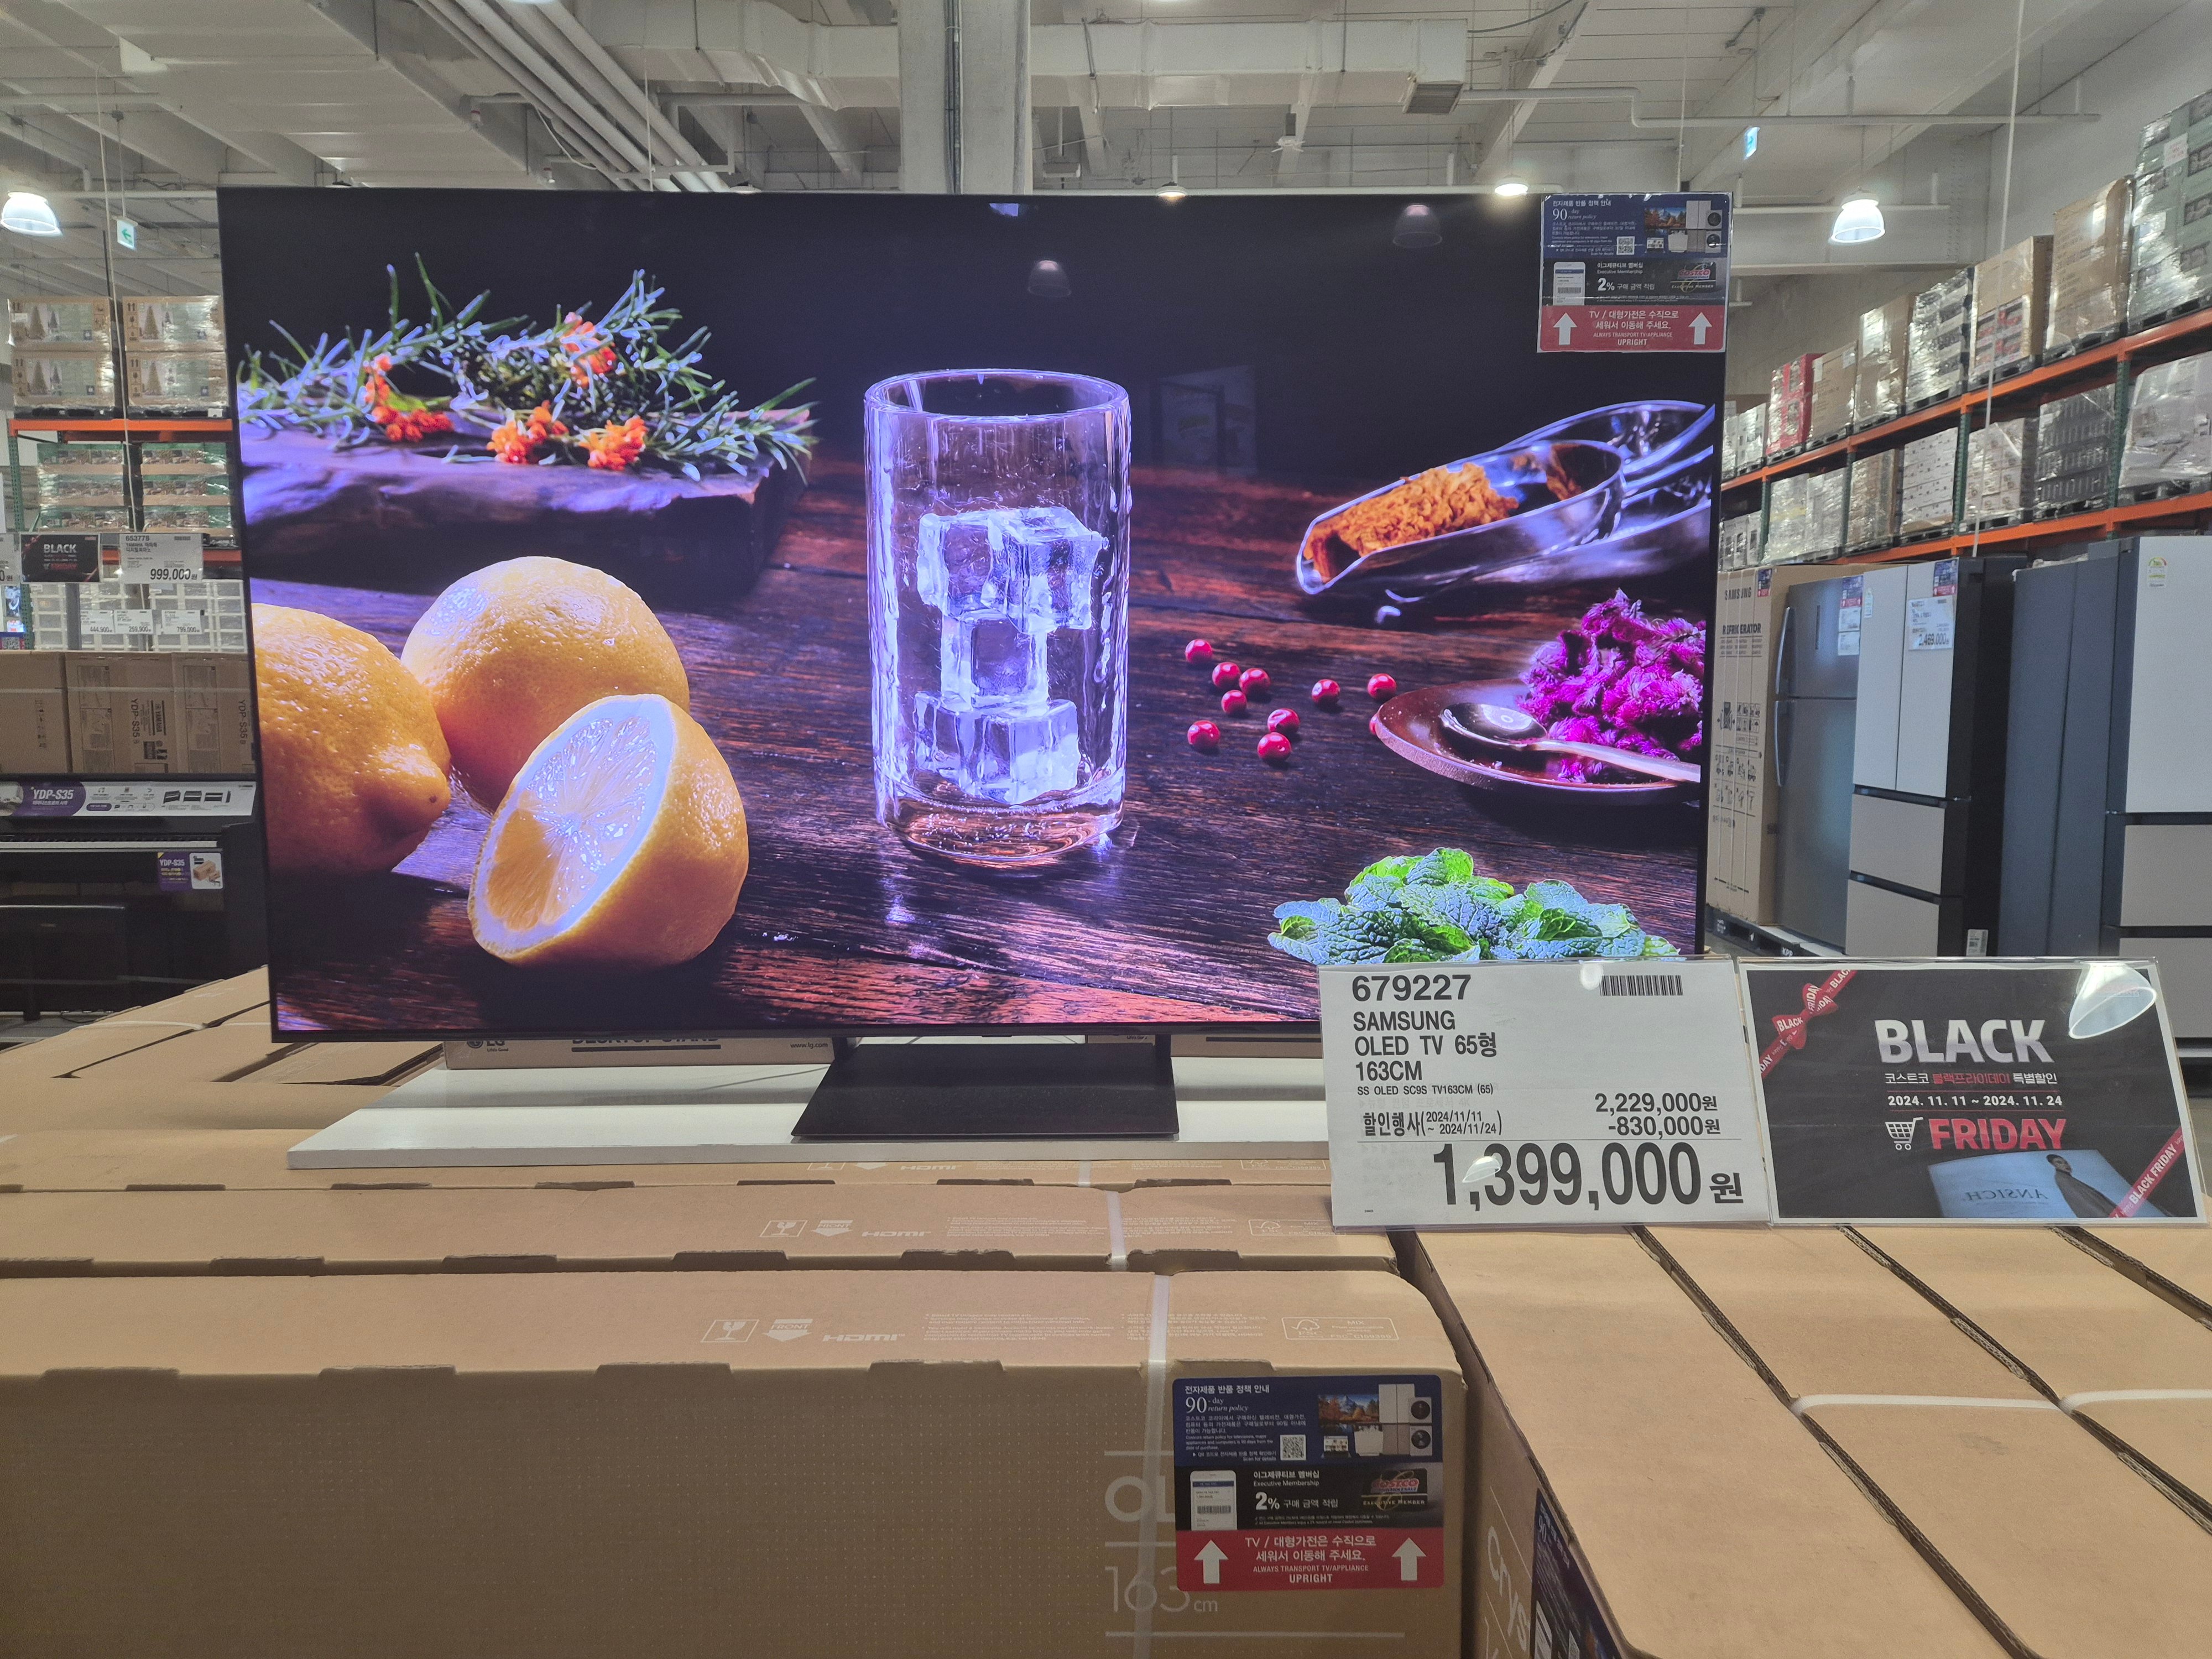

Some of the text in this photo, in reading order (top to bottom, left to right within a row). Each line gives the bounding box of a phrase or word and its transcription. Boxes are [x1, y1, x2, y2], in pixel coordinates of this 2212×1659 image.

[1552, 208, 1567, 220] 90
[1597, 278, 1615, 291] 2%
[1609, 310, 1646, 319] 대형가전은
[1648, 310, 1679, 319] 수직으로
[1596, 321, 1671, 330] 세워서 이동해 주세요.
[44, 544, 77, 553] BLACK
[150, 568, 191, 581] 999,000
[131, 698, 140, 738] YDP-S35
[33, 789, 74, 800] YDP-S35
[1352, 974, 1471, 1001] 679227
[1353, 1010, 1455, 1031] SAMSUNG
[1777, 1016, 1803, 1032] BLACK
[1354, 1032, 1497, 1057] OLED TV 65형
[1875, 1019, 2055, 1063] BLACK
[1355, 1061, 1422, 1081] 163CM
[1885, 1072, 2058, 1084] 코스트코 블랙프라이데이 특별할인
[1357, 1083, 1493, 1095] SS OLED SC9S TV163CM (65)
[1595, 1093, 1718, 1116] 2,229,000원
[1887, 1095, 1924, 1106] 2024.
[1928, 1095, 1948, 1106] 11.
[1952, 1095, 1966, 1106] 11
[1984, 1095, 2020, 1106] 2024.
[2023, 1095, 2043, 1106] 11.
[2047, 1095, 2063, 1106] 24
[1426, 1109, 1482, 1122] 2024/11/11
[1928, 1118, 2067, 1150] FRIDAY
[1433, 1142, 1744, 1211] 1,399,000 원
[2129, 1143, 2177, 1204] BLACK FRIDAY
[1185, 1384, 1270, 1394] 전자제품 반품 정책 안내
[1185, 1397, 1207, 1413] 90
[1229, 1405, 1249, 1413] policy
[1253, 1470, 1319, 1479] 이그제큐티브 멤버십
[1105, 1474, 1175, 1522] OL
[1255, 1491, 1338, 1510] 2% 구매 금액 적립
[1245, 1537, 1260, 1547] TV
[1274, 1536, 1328, 1548] 대형가전은
[1332, 1535, 1376, 1547] 수직으로
[1256, 1549, 1365, 1562] 세워서 이동해 주세요.
[1289, 1573, 1333, 1583] UPRIGHT
[1487, 1526, 1531, 1652] Crys
